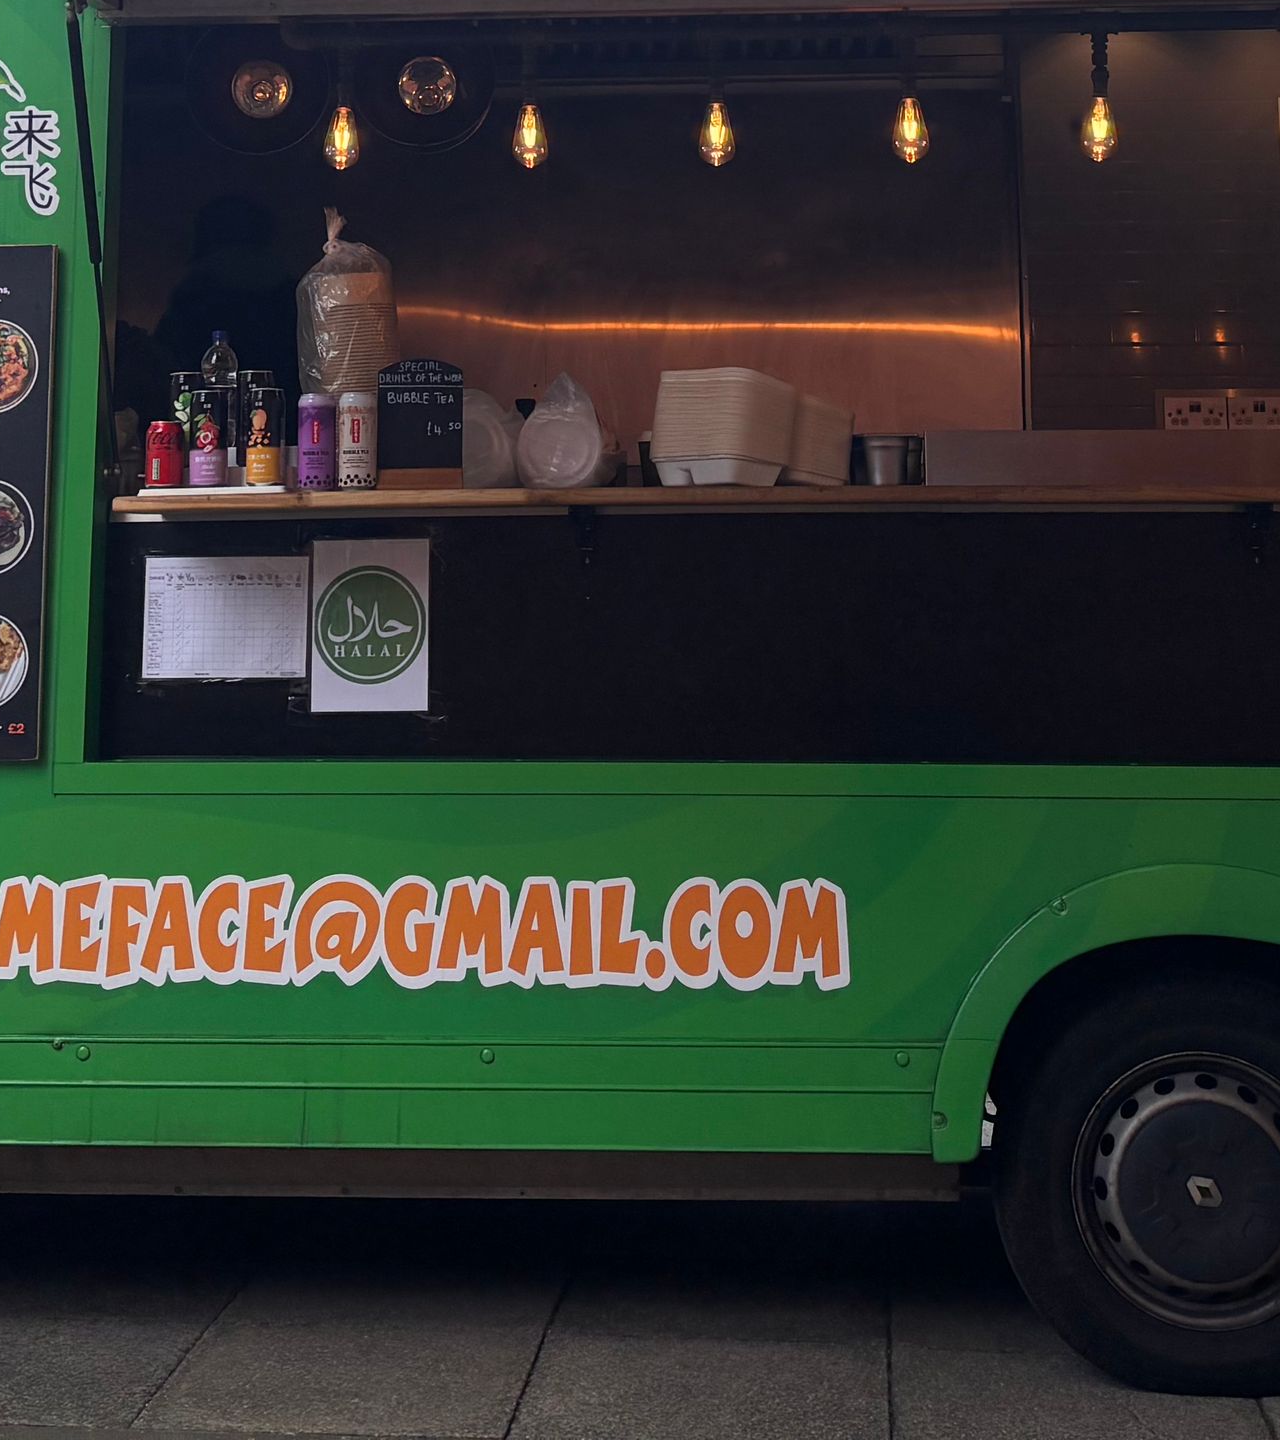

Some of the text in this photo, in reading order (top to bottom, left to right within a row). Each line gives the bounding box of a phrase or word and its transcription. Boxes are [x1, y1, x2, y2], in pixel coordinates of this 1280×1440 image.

[2, 108, 58, 212] 来飞
[399, 361, 443, 372] SPECIAL
[379, 374, 411, 384] DRINKS
[415, 374, 426, 382] OF
[429, 372, 441, 383] THE
[387, 392, 455, 404] BUBBLE TEA
[327, 595, 415, 643] حلال
[334, 644, 405, 658] HALAL
[7, 723, 25, 734] £2
